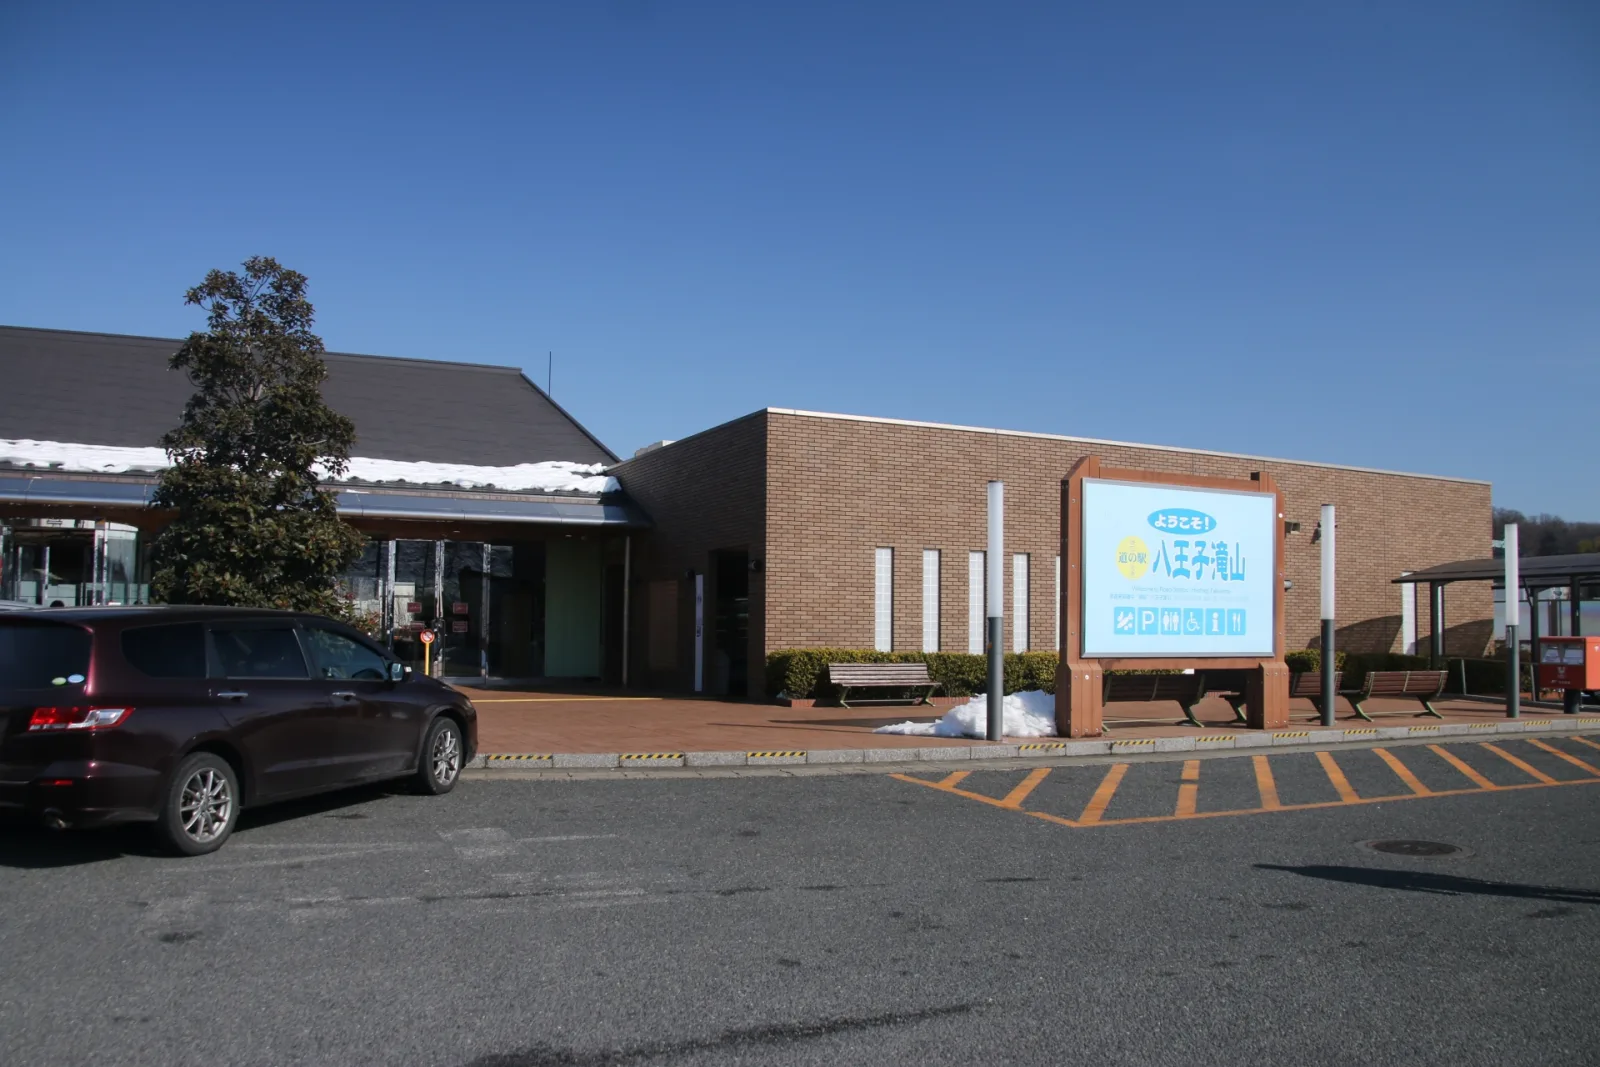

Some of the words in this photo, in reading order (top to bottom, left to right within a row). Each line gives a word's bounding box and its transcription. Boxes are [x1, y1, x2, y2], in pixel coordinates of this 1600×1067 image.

[1154, 514, 1209, 530] ようこそ!
[1118, 552, 1147, 564] 道の駅
[1153, 540, 1245, 581] 八王子滝山
